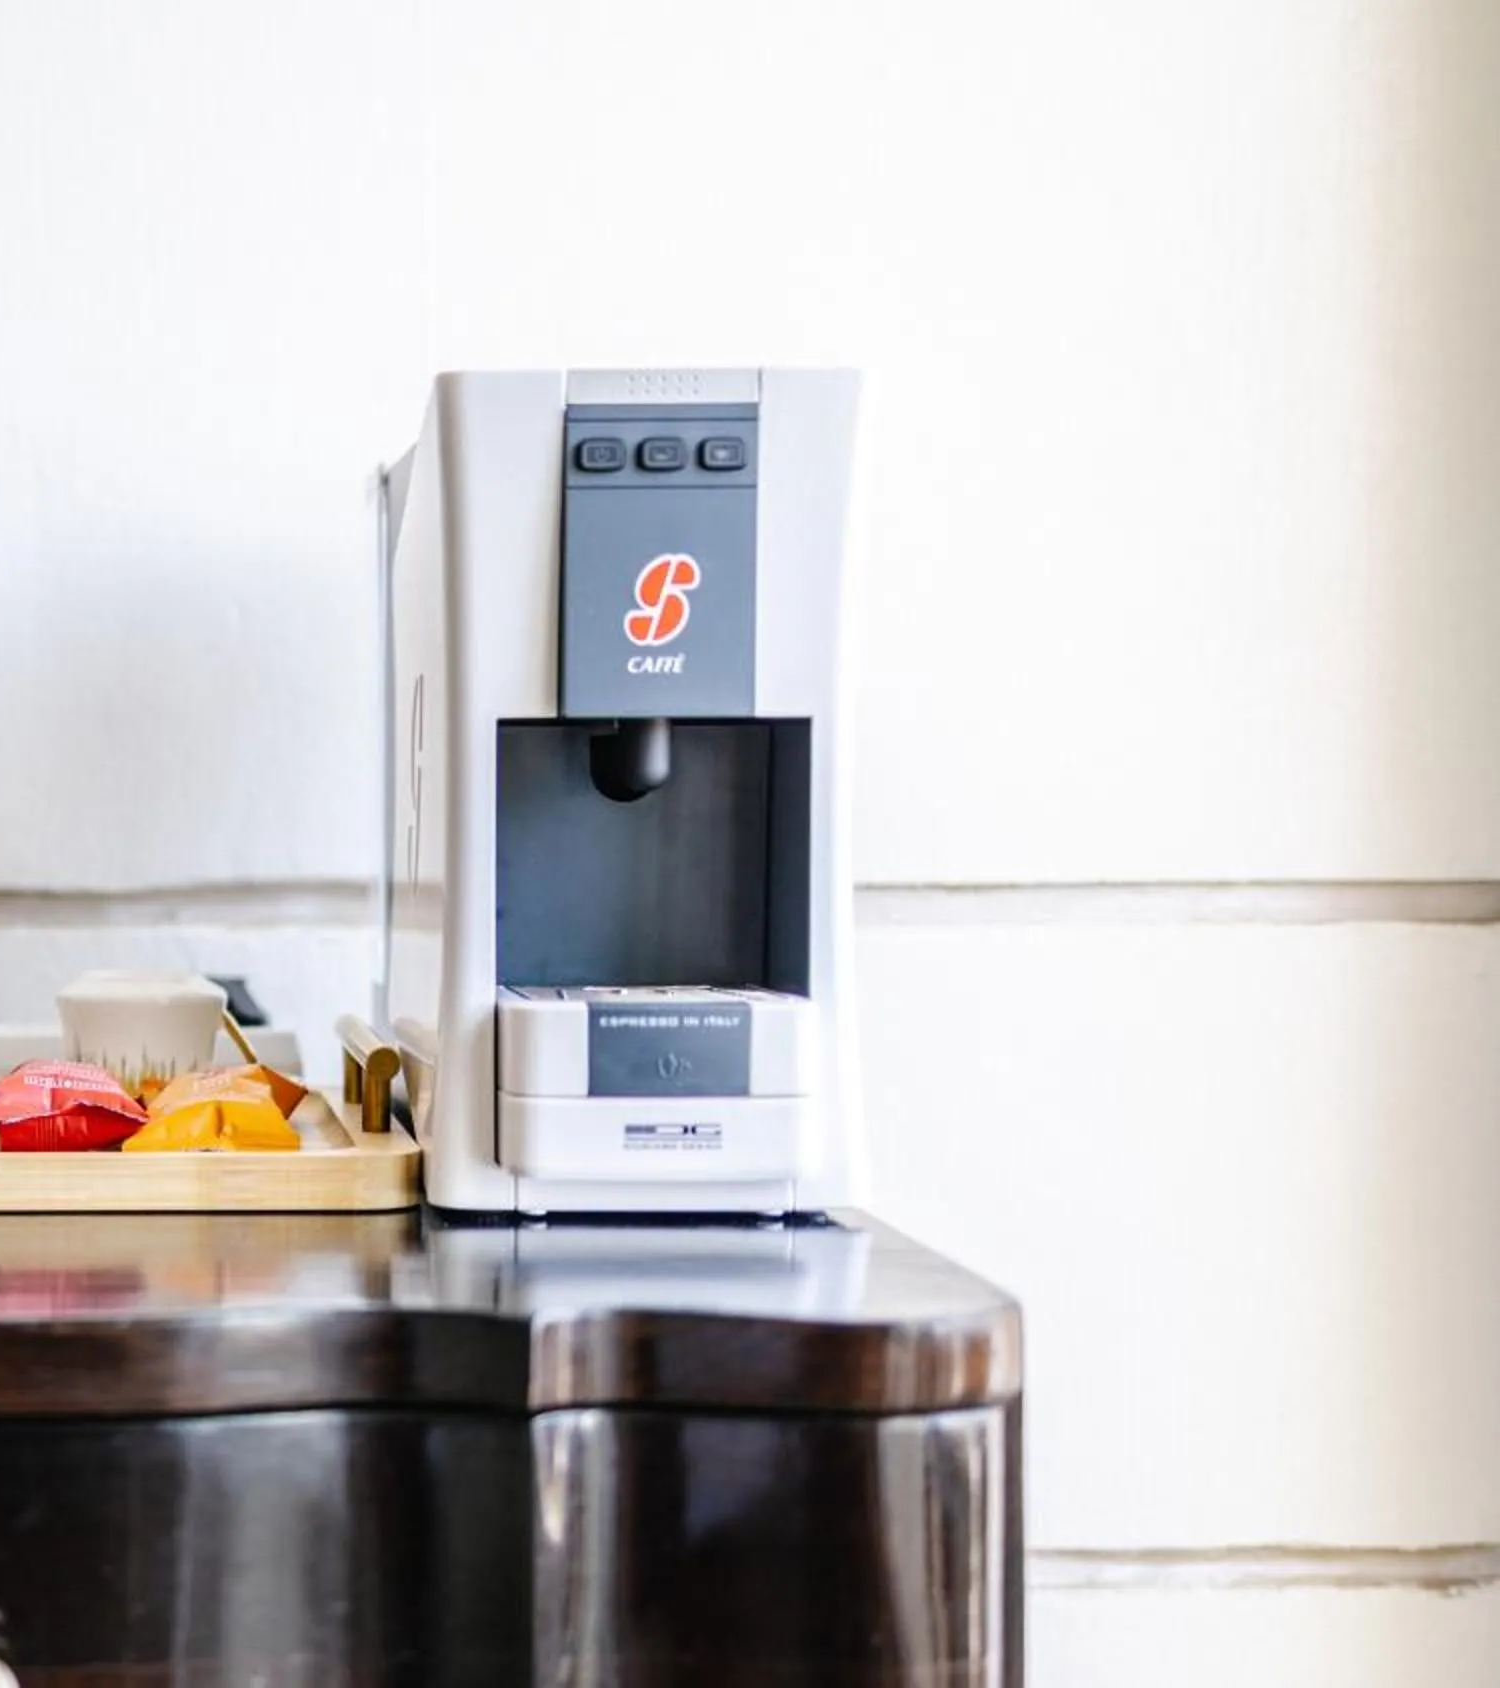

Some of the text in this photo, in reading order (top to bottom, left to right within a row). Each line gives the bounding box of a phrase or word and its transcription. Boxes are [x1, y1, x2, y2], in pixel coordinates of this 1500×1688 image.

[599, 1015, 740, 1027] ESPRESSO IN ITALY
